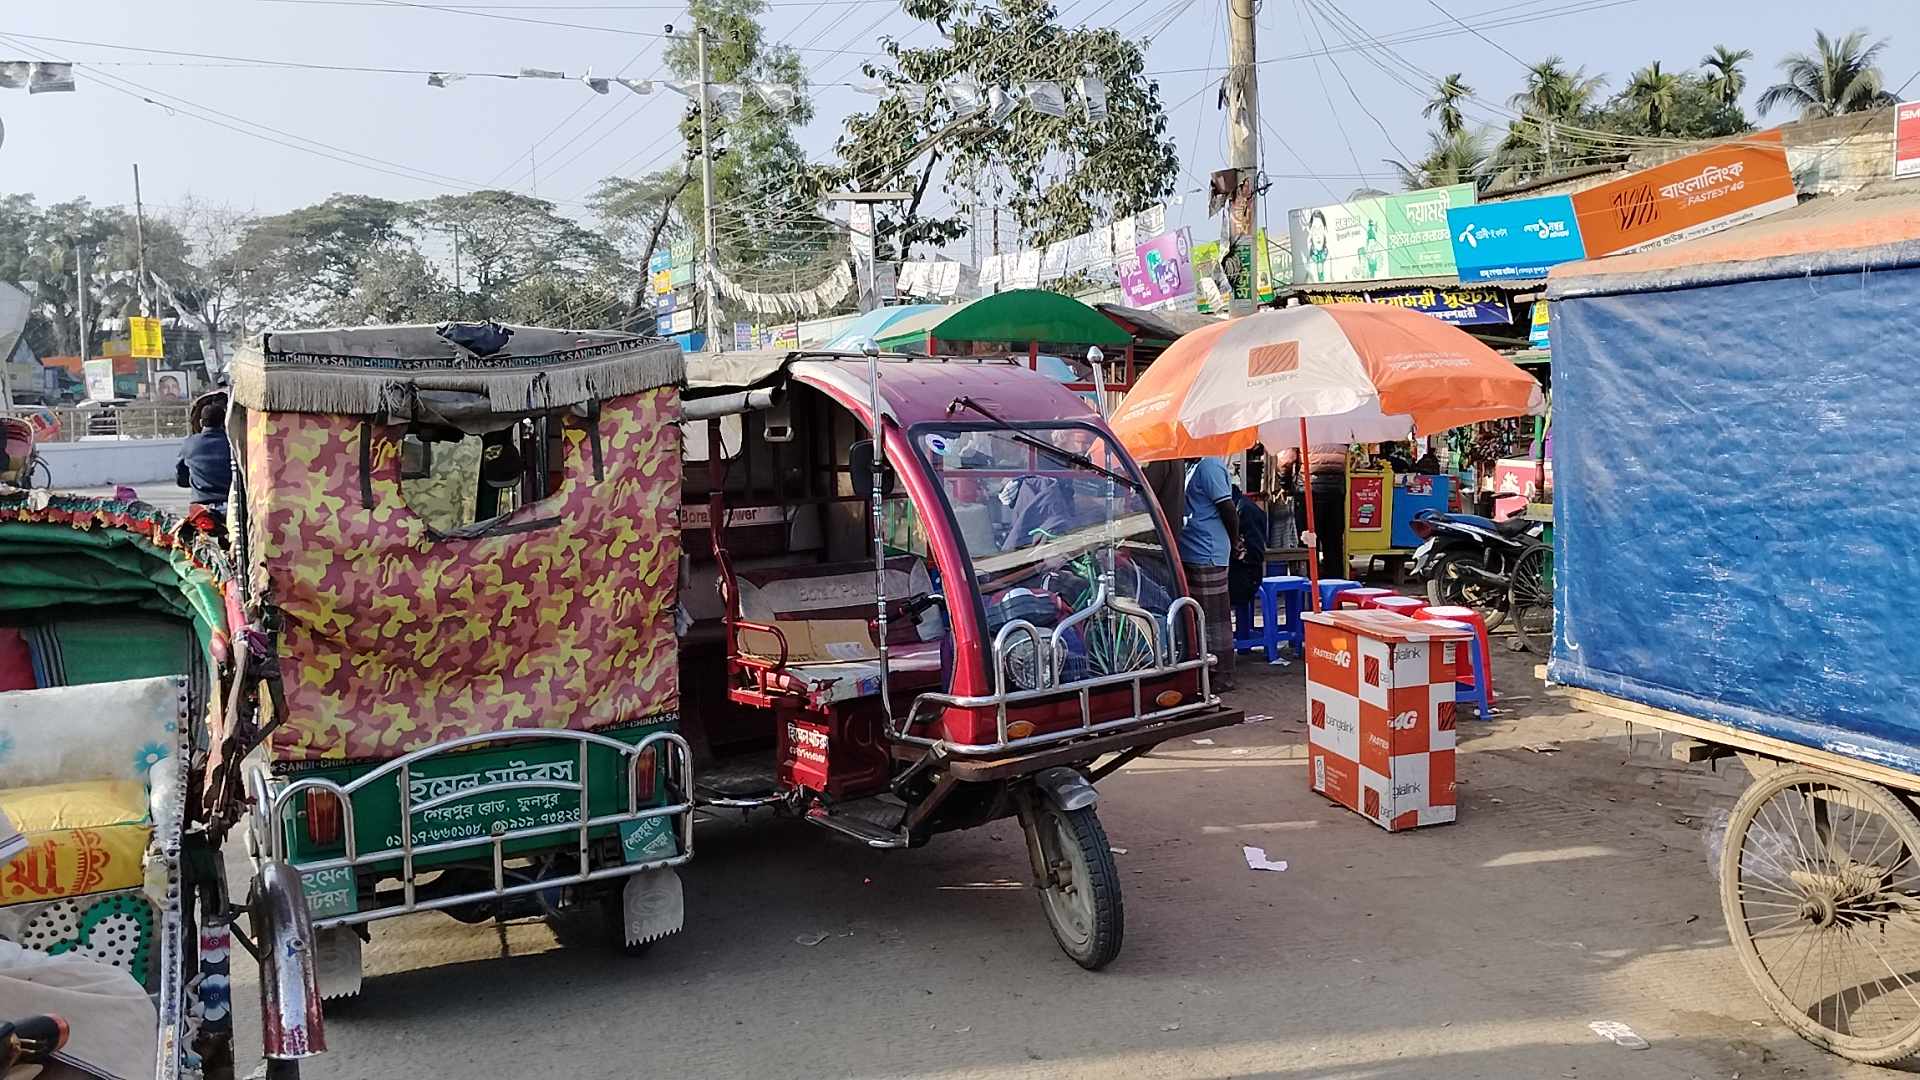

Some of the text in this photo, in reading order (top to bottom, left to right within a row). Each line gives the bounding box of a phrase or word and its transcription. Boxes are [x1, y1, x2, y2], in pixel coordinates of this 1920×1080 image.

[1659, 161, 1744, 200] বাংলালিংক
[1687, 180, 1745, 207] FASTEST 4G
[1335, 649, 1352, 668] 4G
[423, 803, 473, 823] শেরপুর
[517, 792, 561, 812] ফুলপুর
